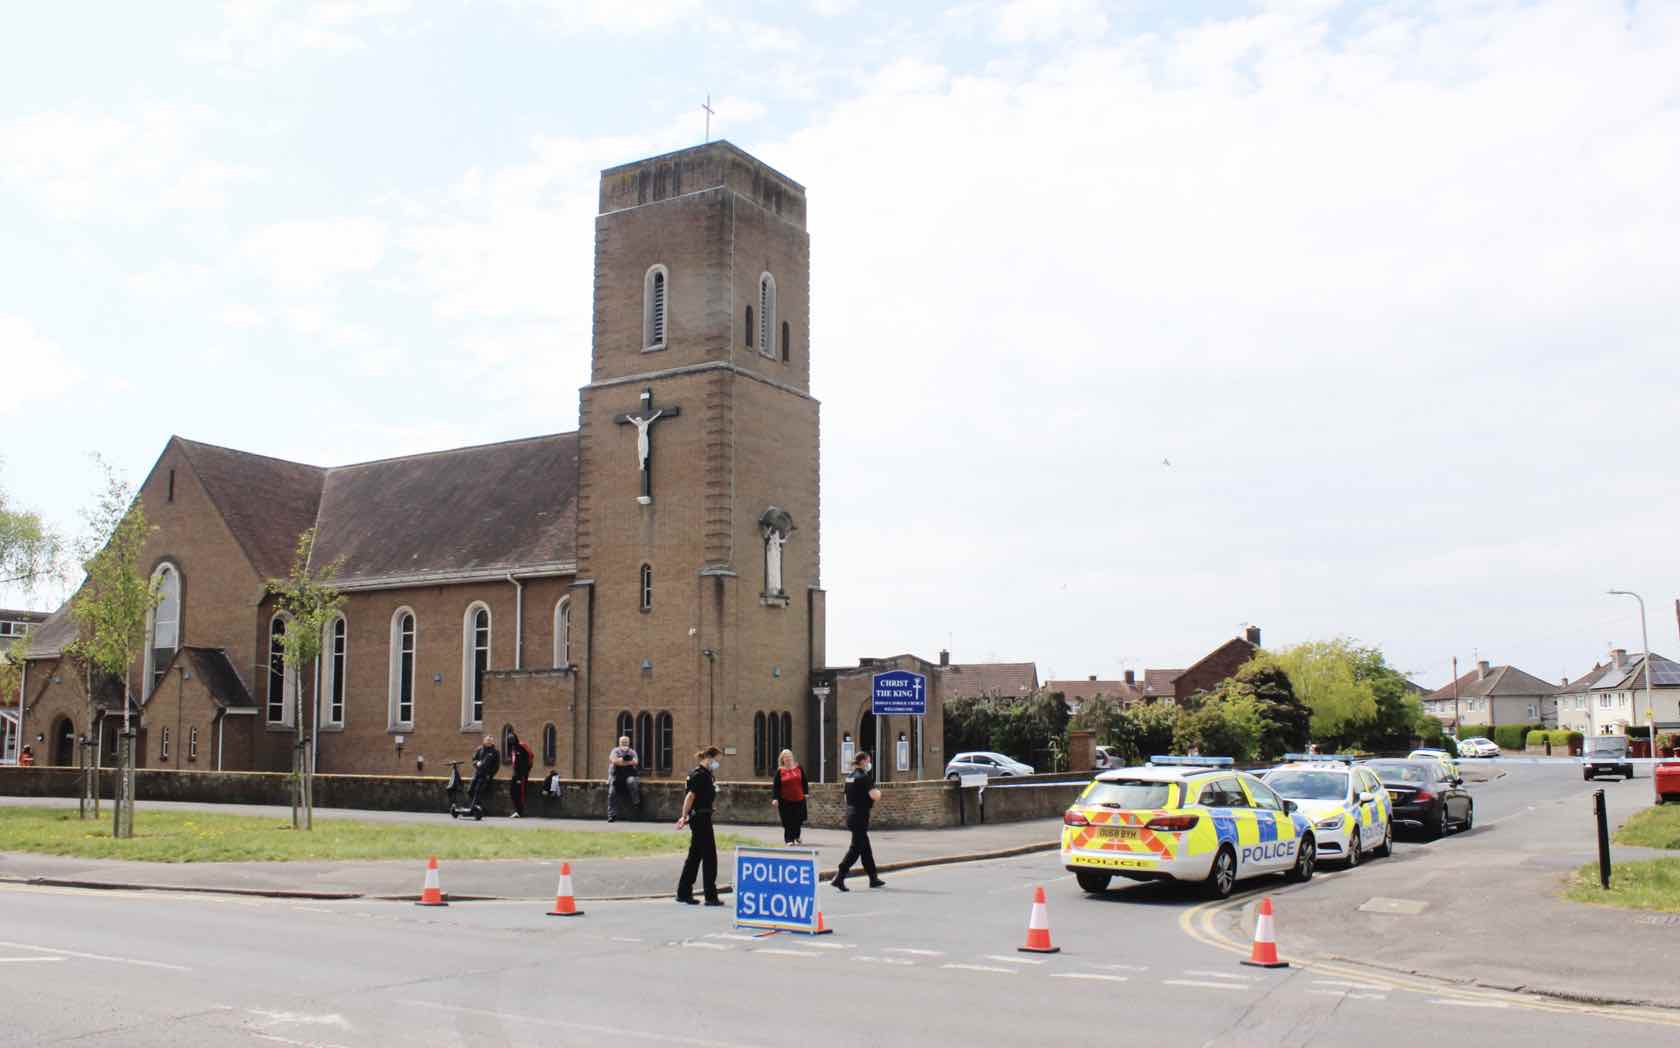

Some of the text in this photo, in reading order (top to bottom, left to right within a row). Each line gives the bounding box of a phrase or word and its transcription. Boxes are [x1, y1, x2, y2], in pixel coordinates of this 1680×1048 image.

[1075, 857, 1151, 868] POLICE
[1242, 840, 1296, 864] POLICE
[742, 863, 811, 885] POLICE
[743, 891, 809, 919] SLOW
